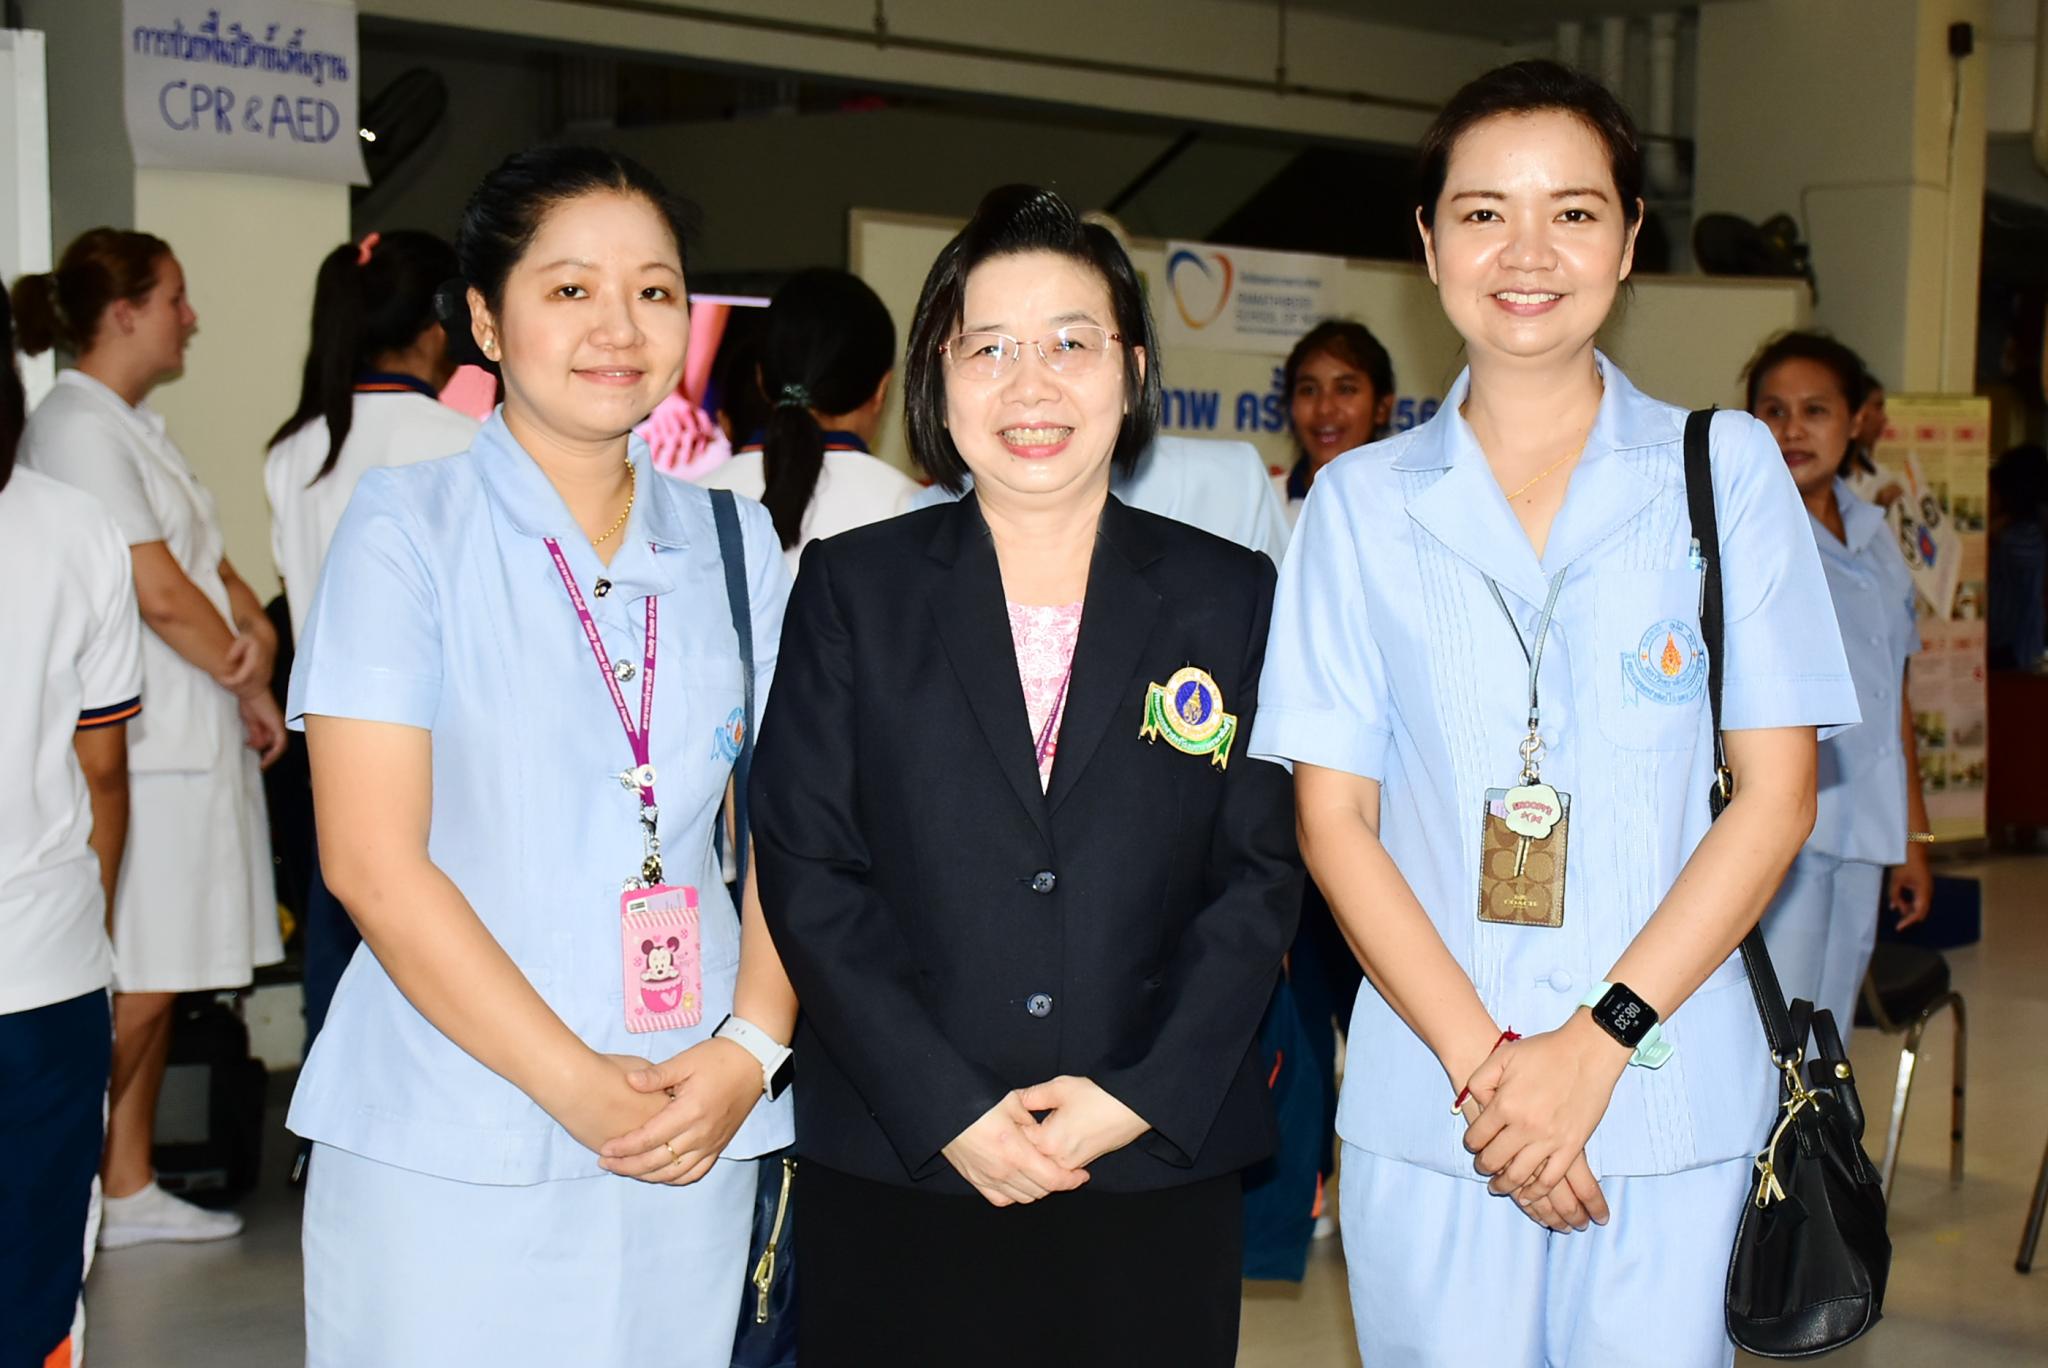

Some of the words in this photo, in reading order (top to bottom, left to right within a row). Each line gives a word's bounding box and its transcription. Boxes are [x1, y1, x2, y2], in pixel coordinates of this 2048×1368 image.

[158, 79, 236, 135] CPR
[241, 95, 264, 133] &
[268, 94, 341, 143] AED
[1614, 1001, 1641, 1030] 08:33
